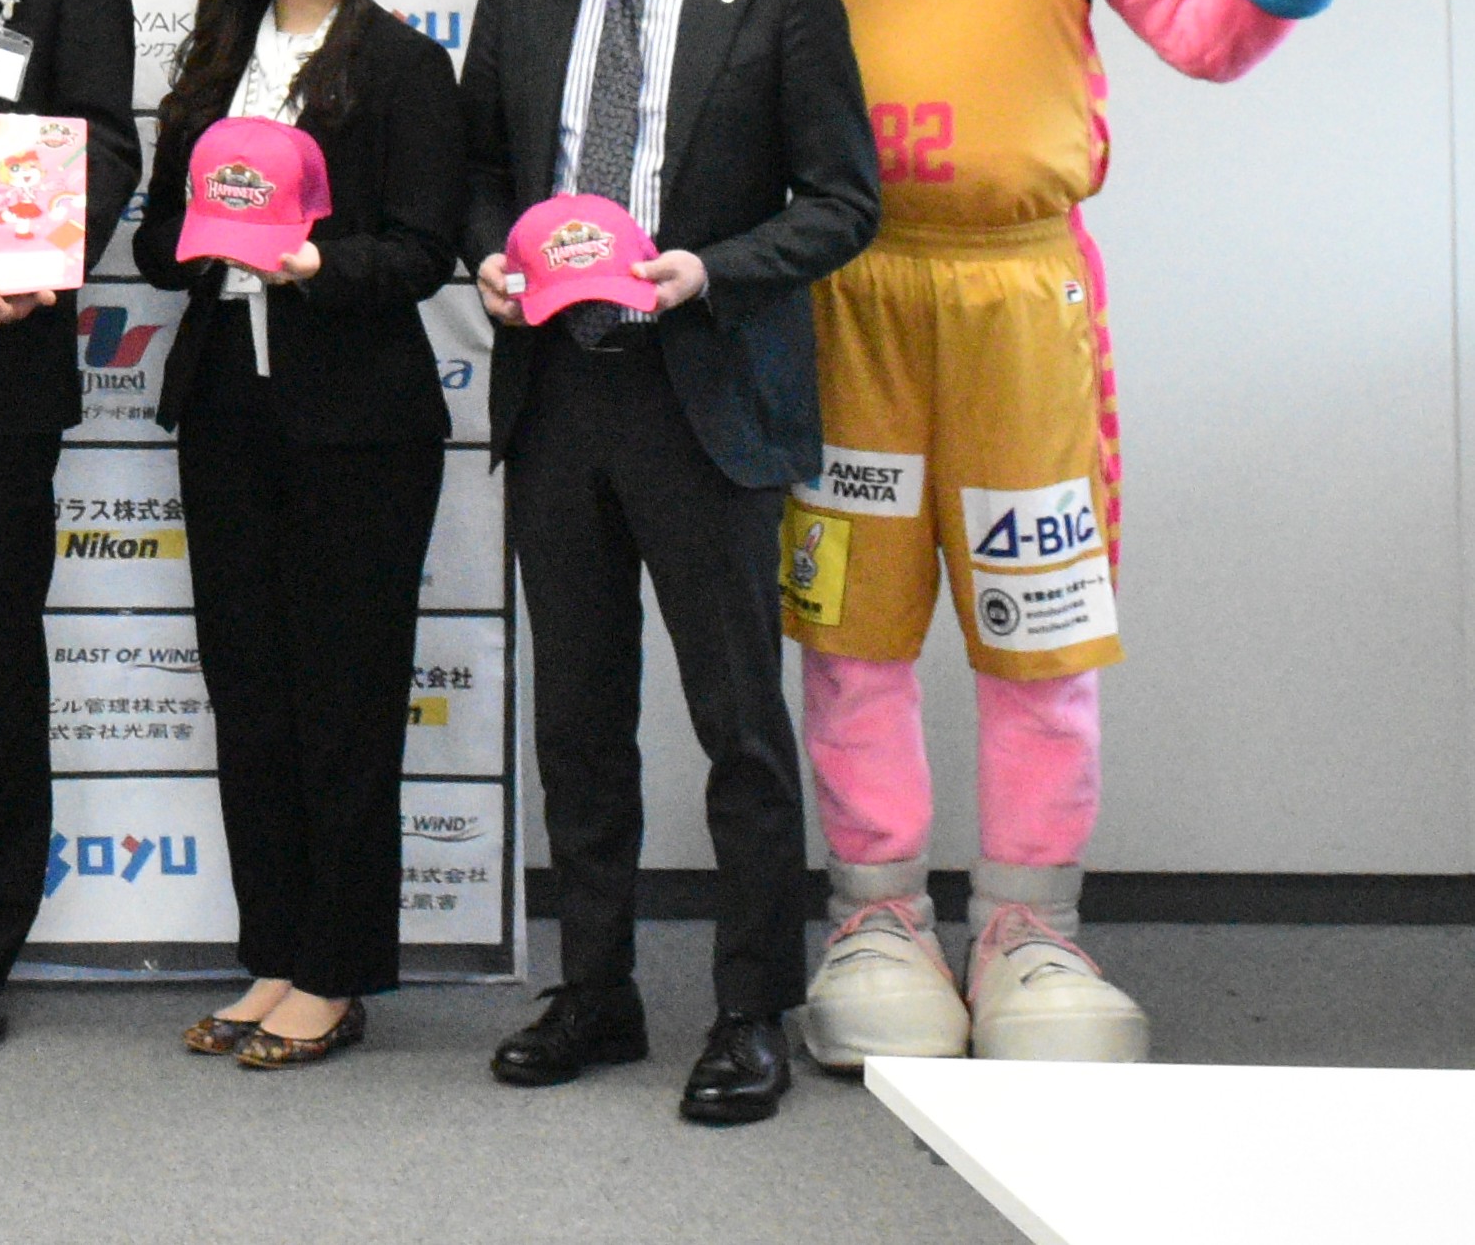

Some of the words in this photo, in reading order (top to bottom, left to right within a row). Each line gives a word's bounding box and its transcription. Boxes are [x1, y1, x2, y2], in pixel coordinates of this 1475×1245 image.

[828, 461, 904, 485] ANEST
[832, 479, 897, 502] IWATA
[64, 533, 159, 559] Nikon
[54, 648, 112, 663] BLAST
[116, 648, 143, 663] OF
